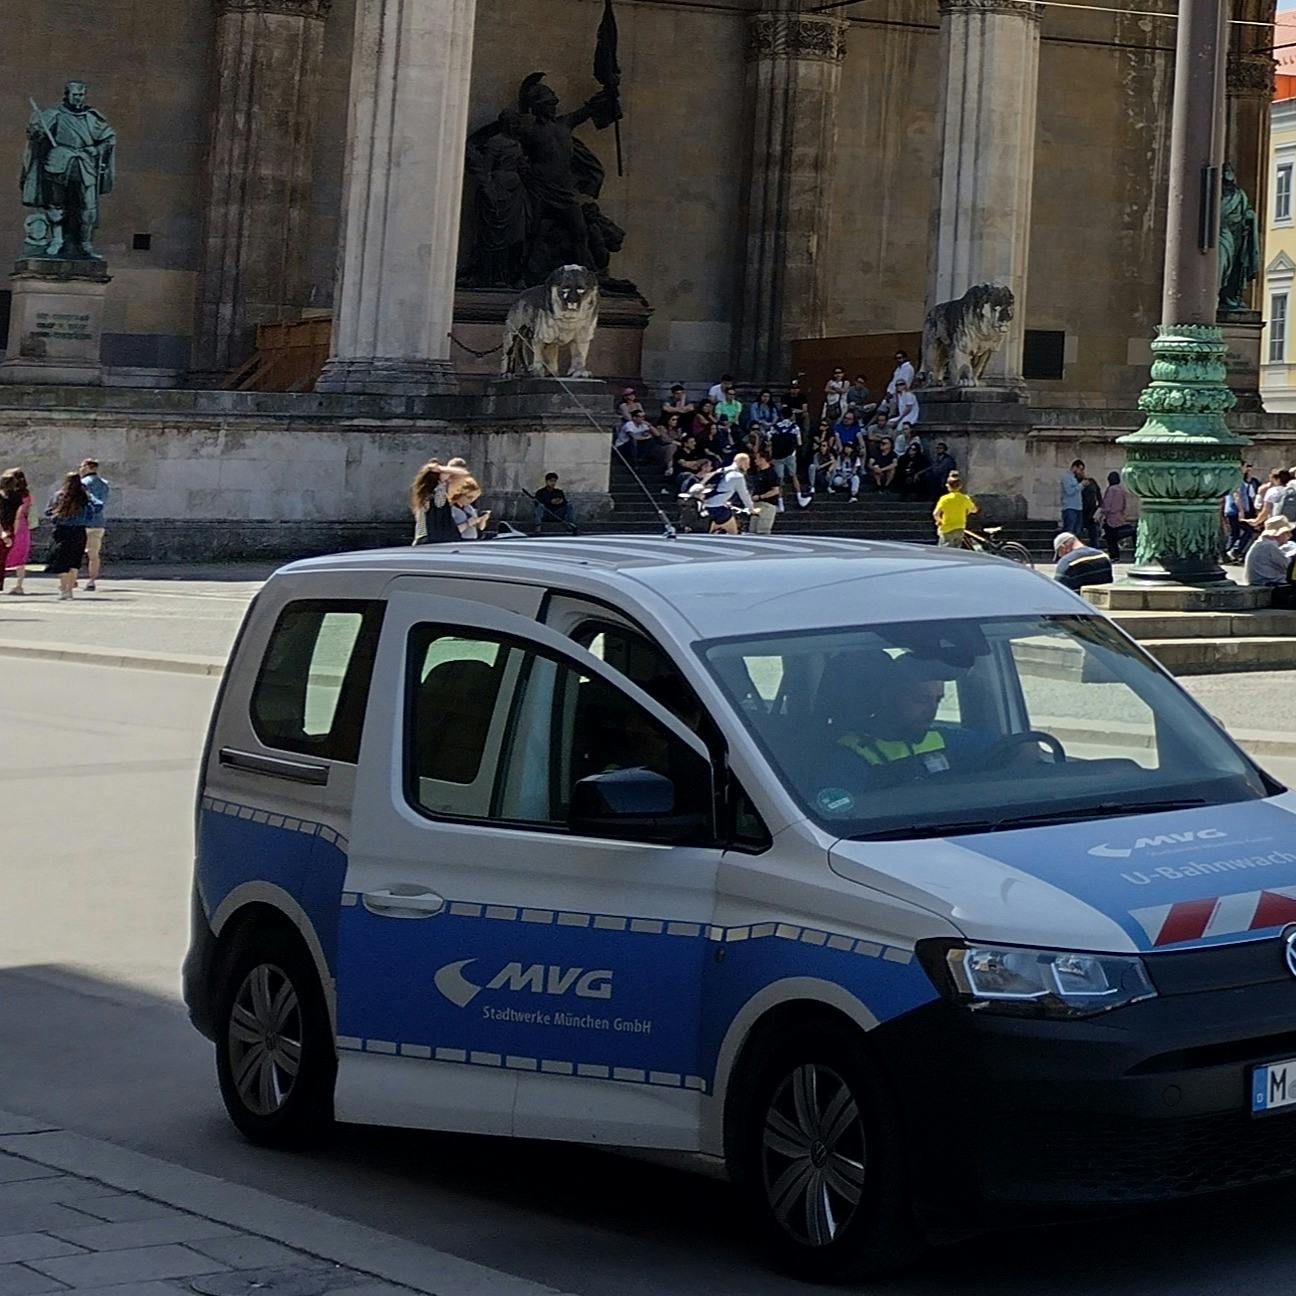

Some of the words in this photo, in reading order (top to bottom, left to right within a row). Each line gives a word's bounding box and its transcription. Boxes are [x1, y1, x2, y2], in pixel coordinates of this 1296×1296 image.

[1134, 828, 1228, 848] MVG
[486, 962, 614, 999] MVG
[482, 1006, 551, 1025] Stadtwerke
[554, 1012, 610, 1030] München
[613, 1017, 652, 1034] GmbH
[1270, 1068, 1287, 1103] M
